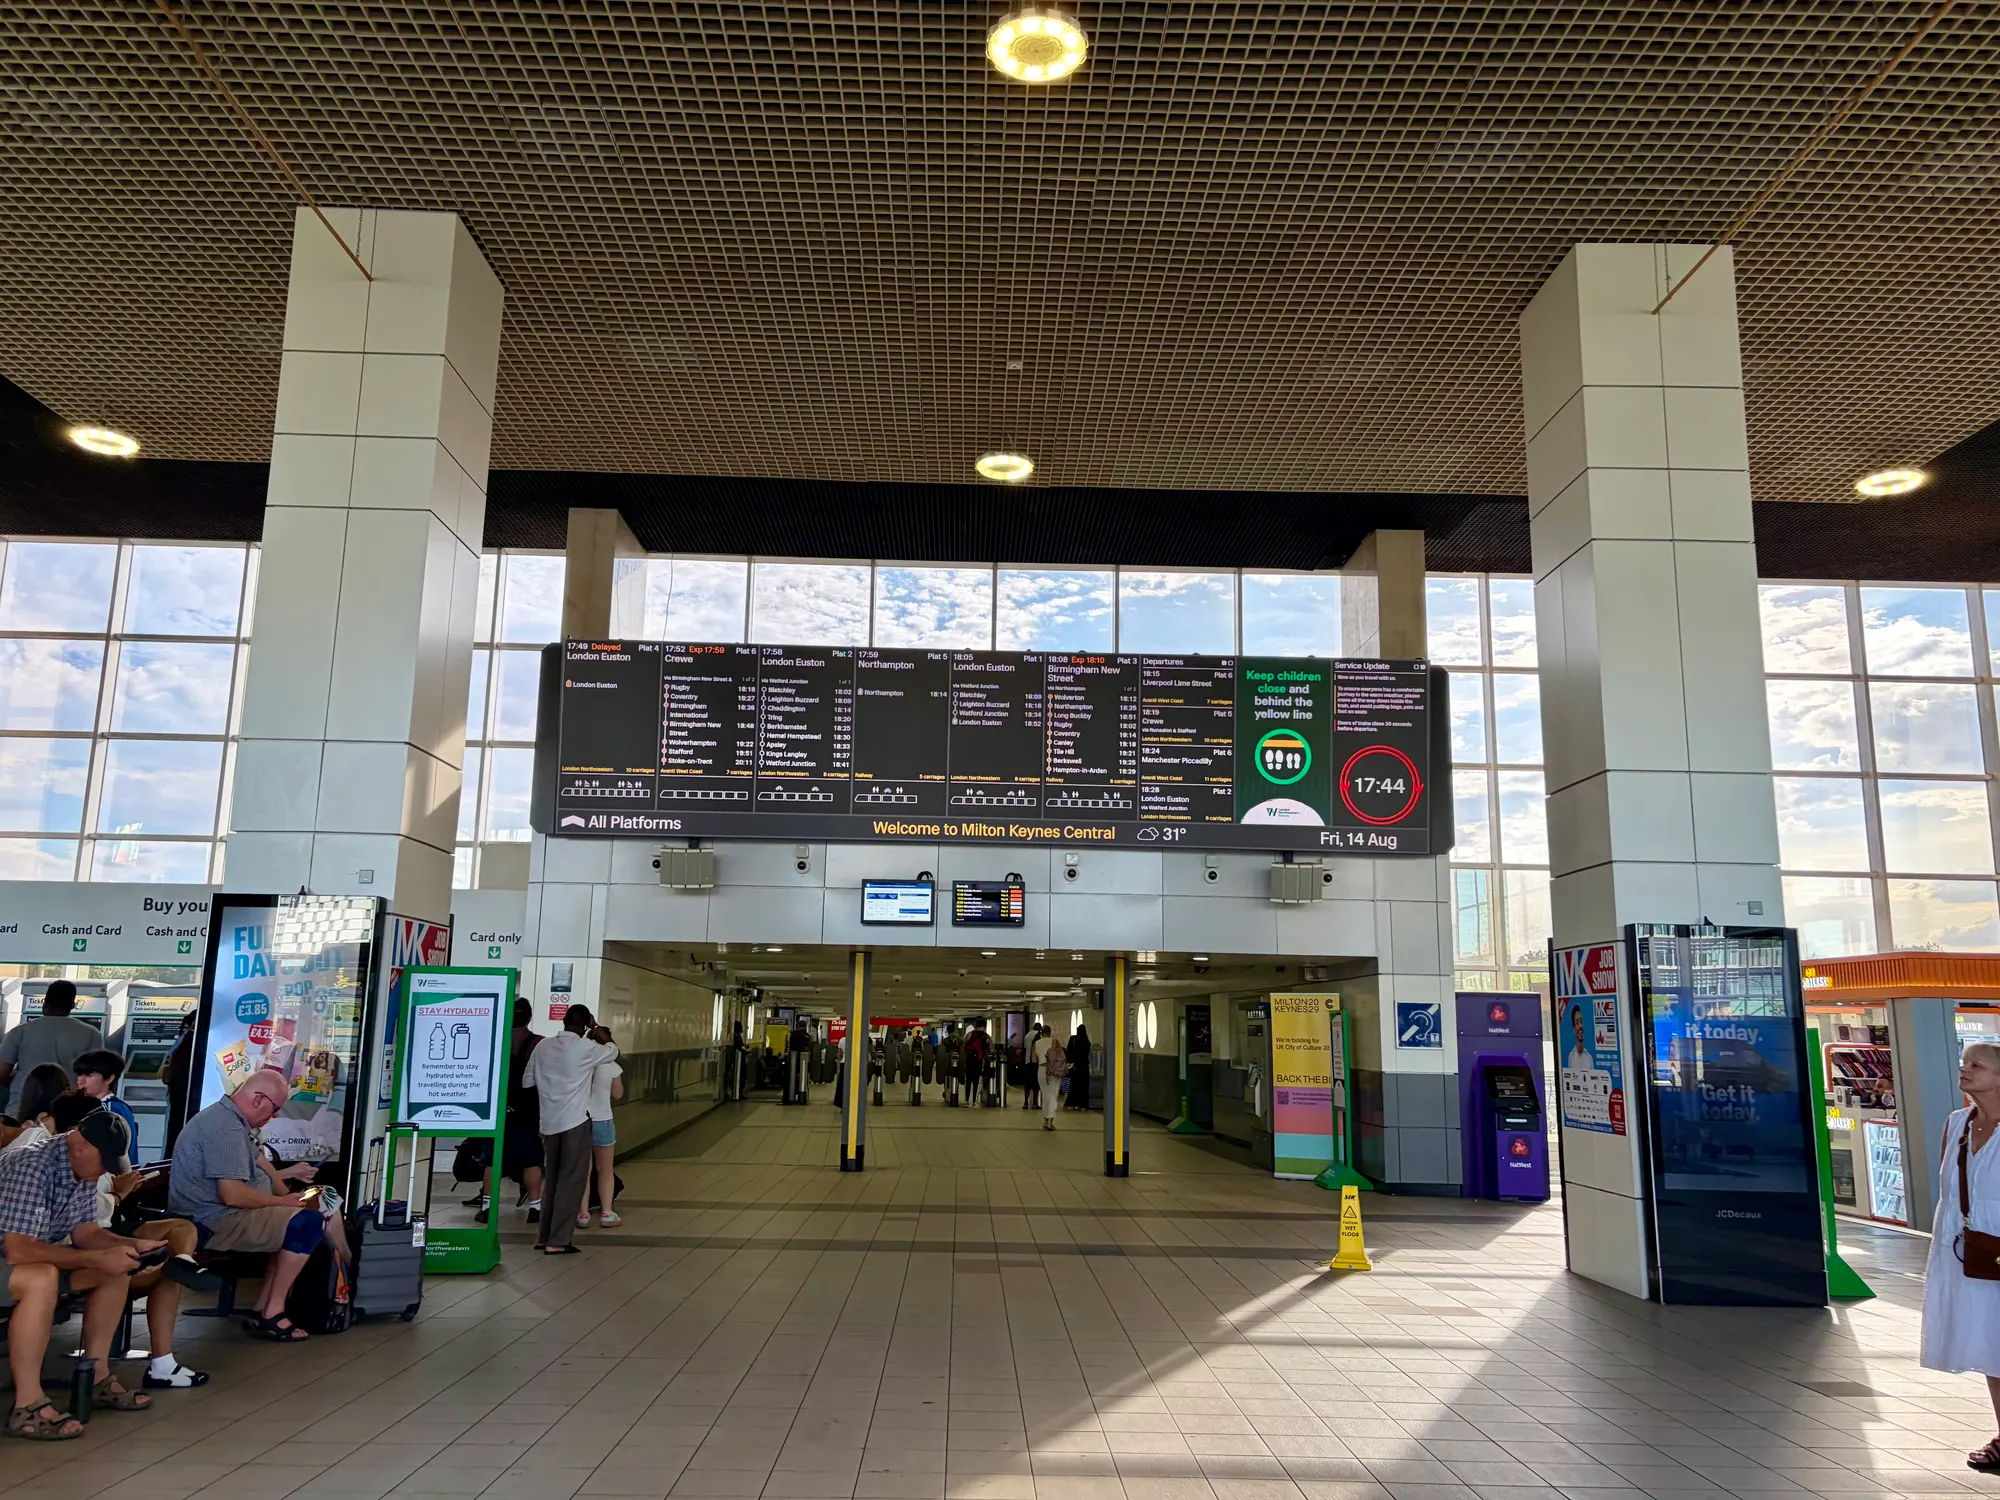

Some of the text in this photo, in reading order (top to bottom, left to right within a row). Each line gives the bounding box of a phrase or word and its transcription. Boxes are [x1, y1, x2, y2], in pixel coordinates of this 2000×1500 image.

[592, 643, 621, 651] Delayed
[567, 652, 631, 661] London Euston
[665, 654, 693, 663] Crewe
[1143, 658, 1184, 666] Departures
[762, 658, 825, 667] London Euston
[858, 660, 914, 670] Northampton
[953, 663, 1015, 672] London Euston
[1048, 665, 1120, 674] Birmingham New
[1048, 674, 1074, 682] Street
[1246, 670, 1321, 682] Keep children
[1142, 679, 1173, 688] Liverpool
[1258, 684, 1309, 694] close and
[864, 689, 904, 697] Northampton
[1255, 696, 1313, 707] behind the
[1254, 709, 1313, 720] yellow line
[1182, 757, 1212, 765] Piccadilly
[1354, 777, 1406, 794] 17:44
[588, 815, 682, 830] All Platforms
[873, 821, 1115, 840] Welcome to Milton Keynes Central
[1162, 828, 1186, 841] 31°
[1320, 832, 1397, 850] Fri, 14 Aug
[143, 898, 208, 915] Buy you
[0, 923, 18, 933] ard
[42, 924, 122, 936] Cash and Card
[146, 926, 173, 936] Cash
[176, 927, 197, 937] and
[395, 918, 429, 966] MK
[434, 930, 446, 949] JOB
[470, 932, 522, 945] Card only
[1599, 949, 1614, 968] JOB
[1559, 949, 1593, 996] MK
[1592, 970, 1615, 990] SHOW
[238, 1004, 267, 1016] £3.85
[250, 1028, 274, 1039] £4.25
[1685, 1022, 1763, 1045] it today.
[1276, 1074, 1302, 1083] BACK
[1303, 1075, 1321, 1083] THE
[1702, 1084, 1755, 1103] Get it
[1701, 1103, 1760, 1123] today.
[1716, 1210, 1762, 1218] JCDecaux
